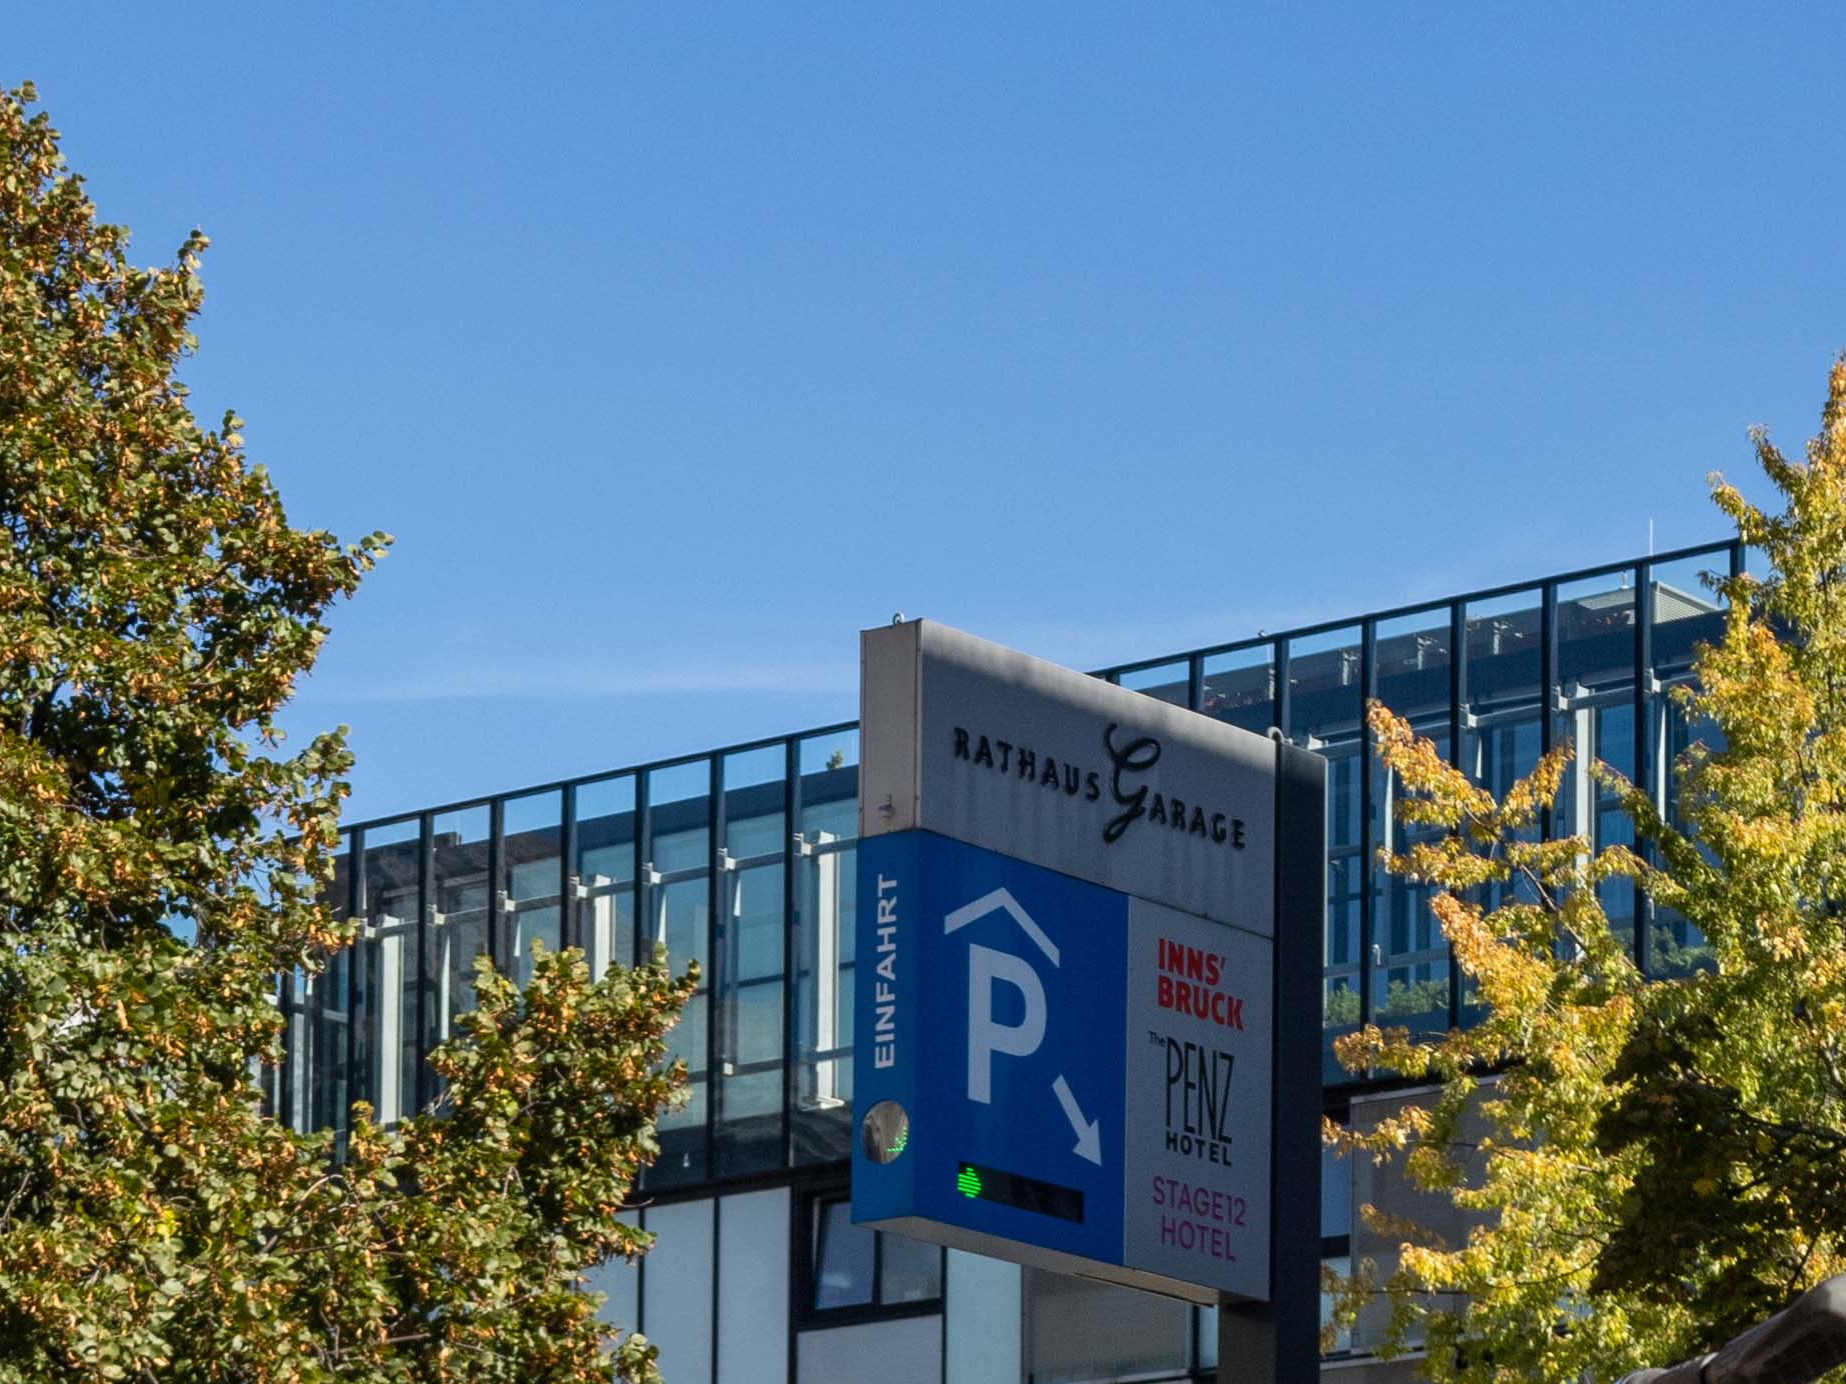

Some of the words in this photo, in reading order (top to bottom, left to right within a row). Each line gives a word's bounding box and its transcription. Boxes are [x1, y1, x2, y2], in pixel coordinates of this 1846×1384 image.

[953, 726, 1101, 803] RATHAUS
[874, 873, 898, 1069] EINFAHRT
[967, 943, 1047, 1104] P
[1157, 975, 1244, 1031] BRUCK
[1147, 1030, 1166, 1048] The
[1166, 1036, 1235, 1145] PENZ
[1165, 1130, 1233, 1167] HOTEL
[1152, 1175, 1247, 1228] STAGE12
[1161, 1214, 1237, 1263] HOTEL
